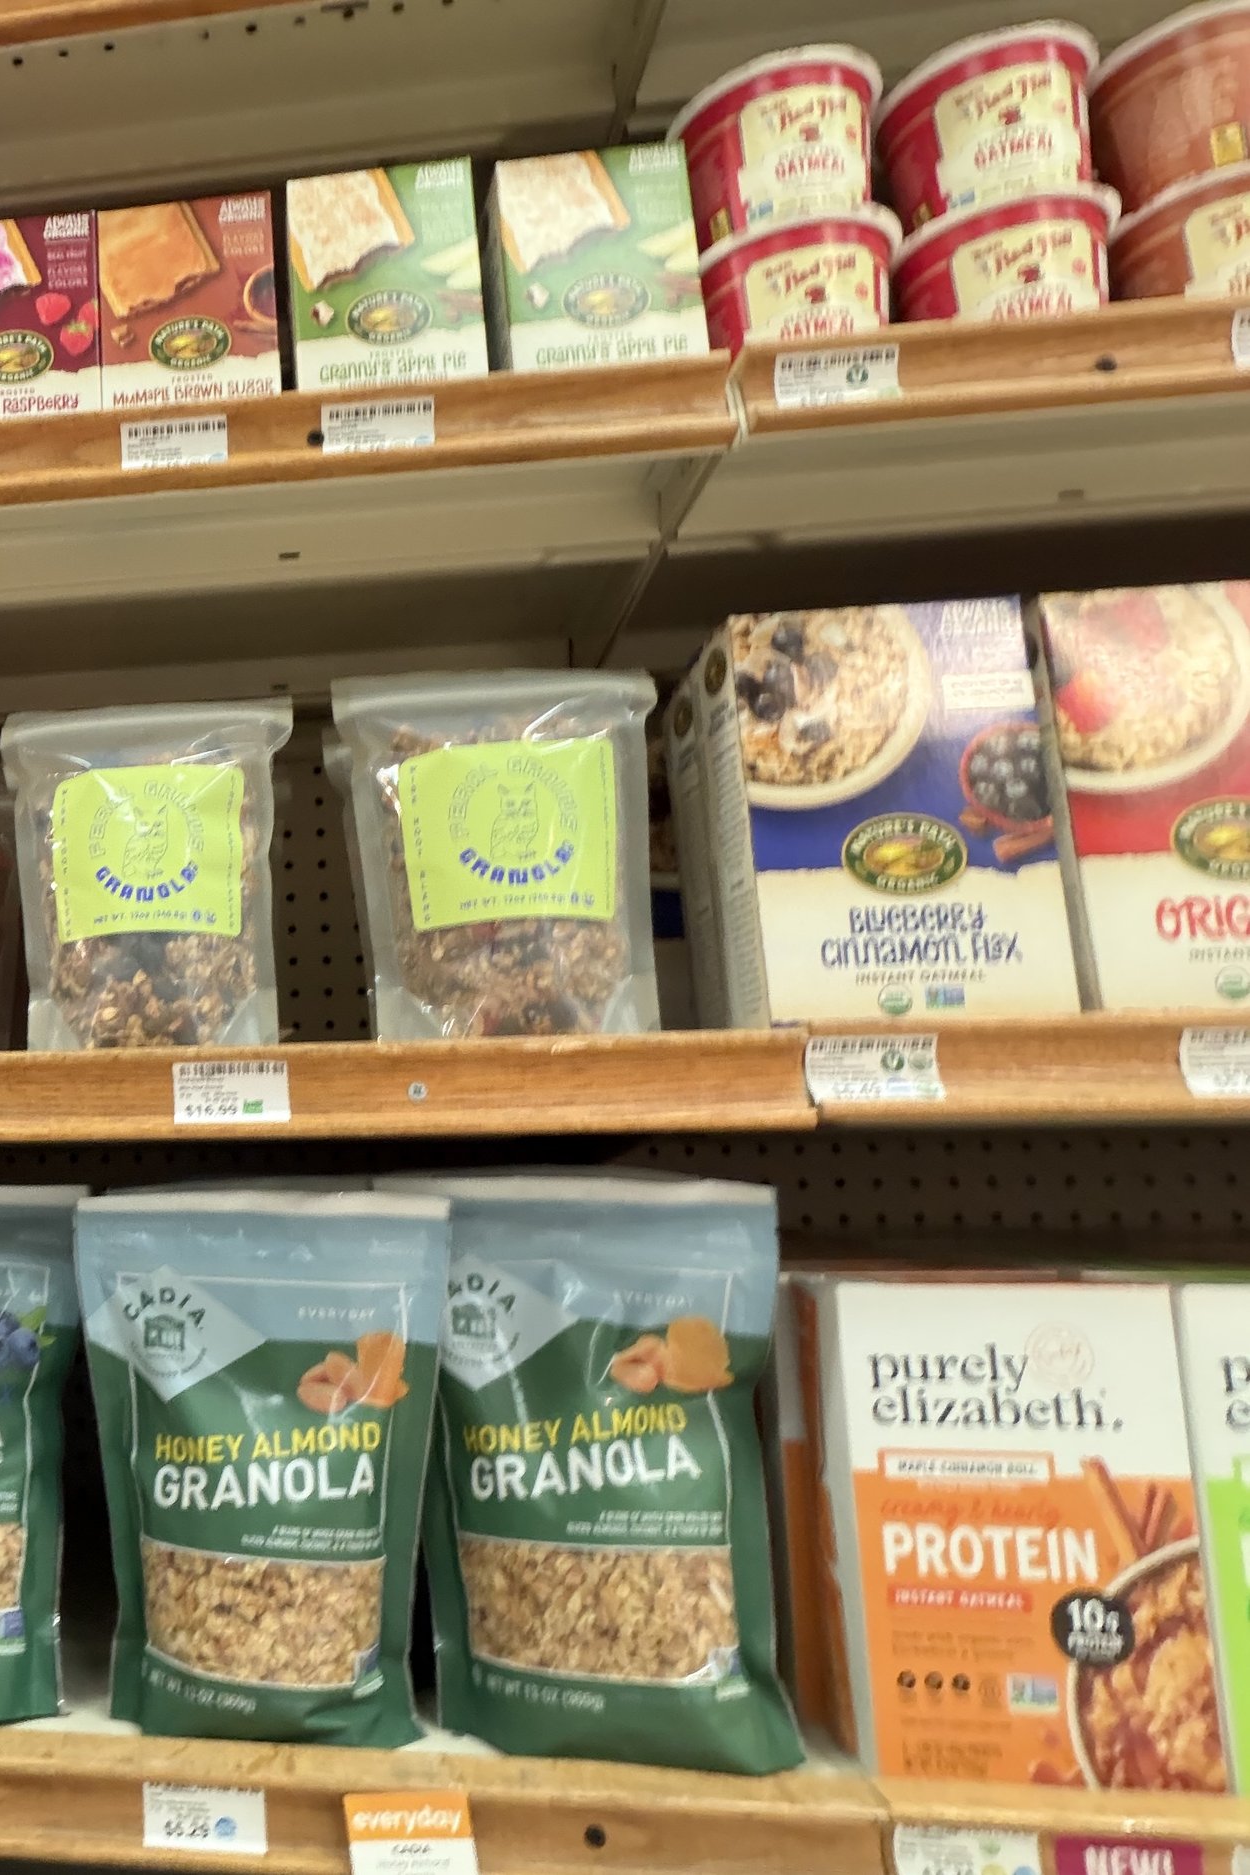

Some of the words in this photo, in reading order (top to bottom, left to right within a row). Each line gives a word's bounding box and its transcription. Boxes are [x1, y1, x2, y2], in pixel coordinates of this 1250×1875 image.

[25, 335, 47, 352] PATH
[155, 320, 199, 343] NATURE'S
[202, 321, 224, 340] PATH
[122, 1286, 207, 1327] CADIA
[299, 1306, 377, 1320] EVERYDAY
[447, 1272, 517, 1315] ADIA
[868, 1342, 1030, 1394] purely
[155, 1431, 246, 1464] HONEY
[251, 1420, 382, 1460] ALMOND
[464, 1417, 563, 1456] HONEY
[570, 1403, 688, 1445] ALMOND
[153, 1452, 375, 1512] GRANOLA
[470, 1433, 703, 1502] GRANOLA
[898, 1461, 935, 1474] MAPLE
[940, 1462, 1003, 1475] CINNAMON
[882, 1521, 1100, 1585] PROTEIN
[895, 1588, 955, 1606] INSTANT
[958, 1591, 1024, 1610] OATMEAL
[352, 1804, 463, 1834] everyday
